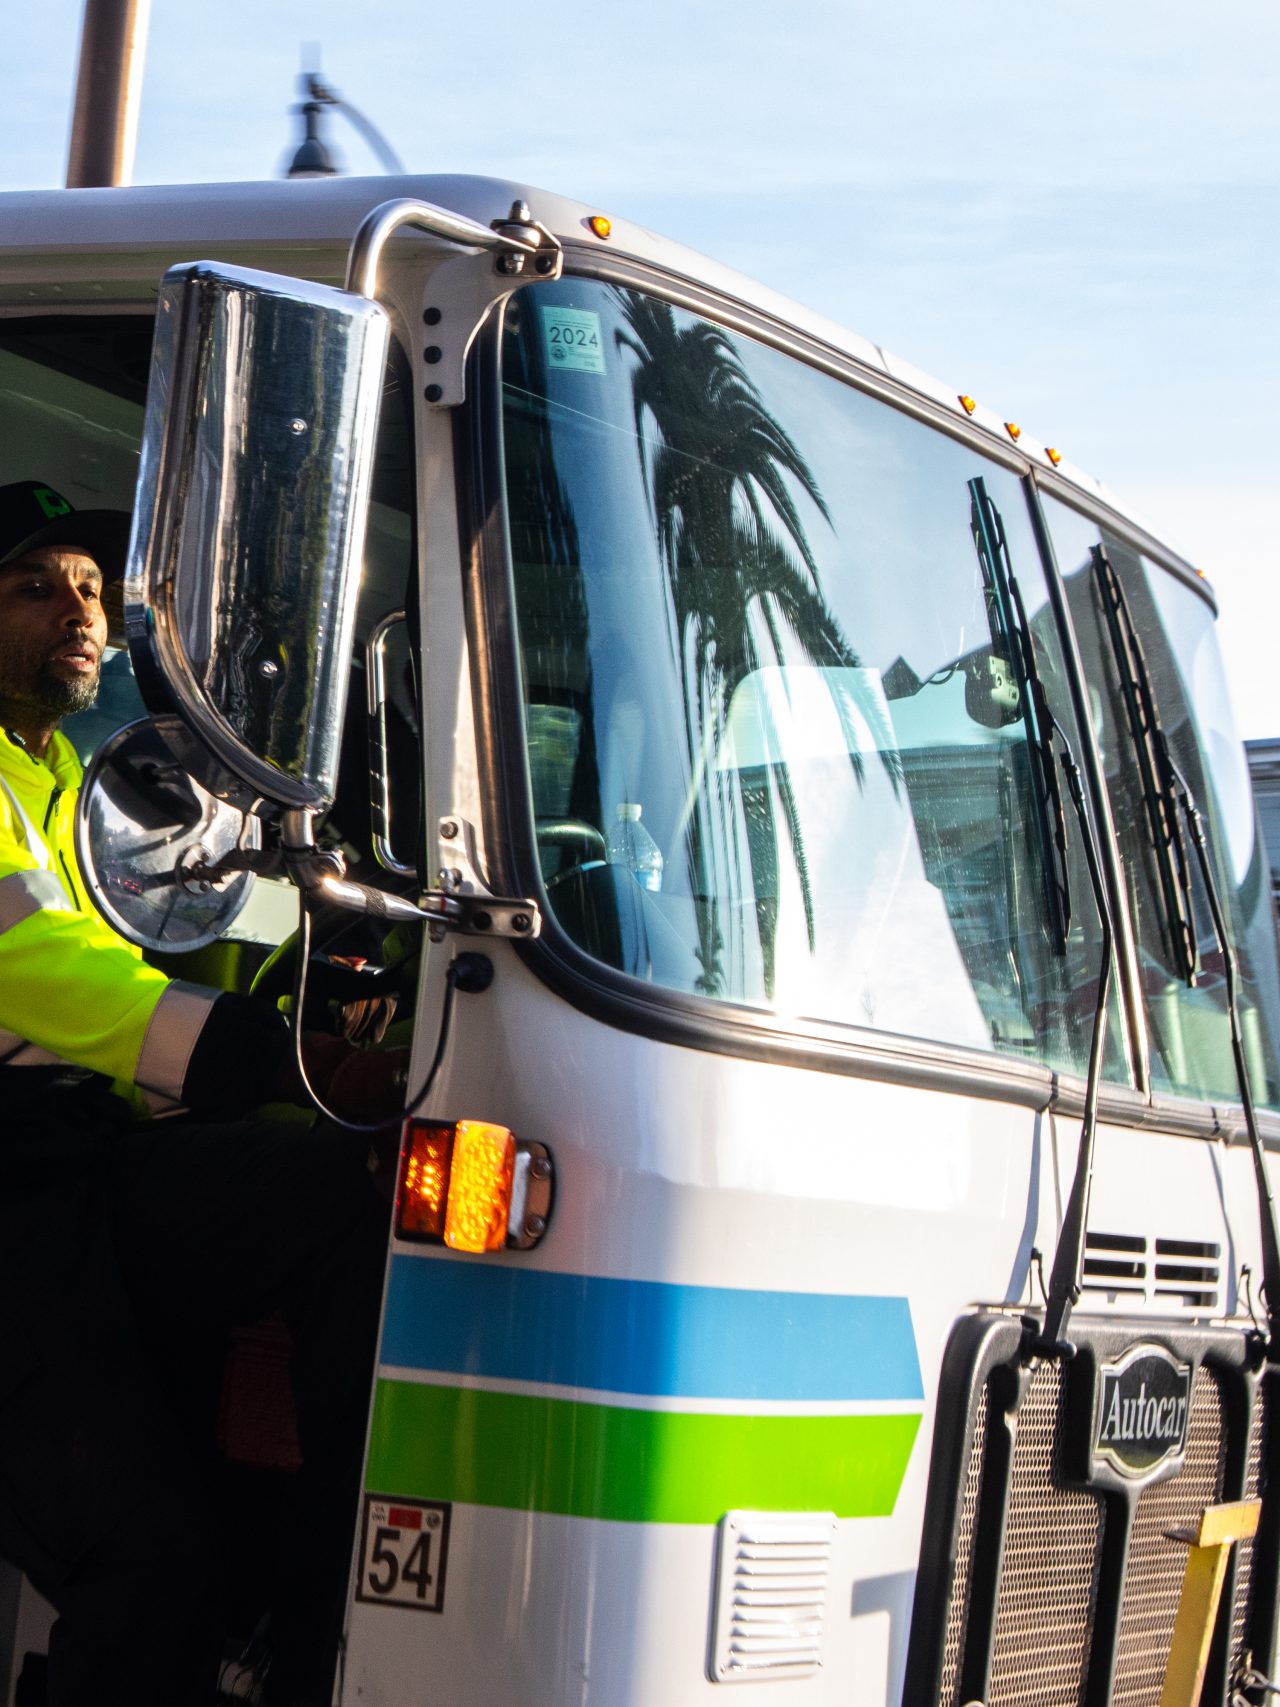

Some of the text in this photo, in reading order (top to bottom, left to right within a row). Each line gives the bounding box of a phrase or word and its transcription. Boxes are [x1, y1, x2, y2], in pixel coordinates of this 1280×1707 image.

[549, 326, 598, 348] 2024
[1101, 1381, 1186, 1441] Autocar
[369, 1527, 432, 1599] 54
